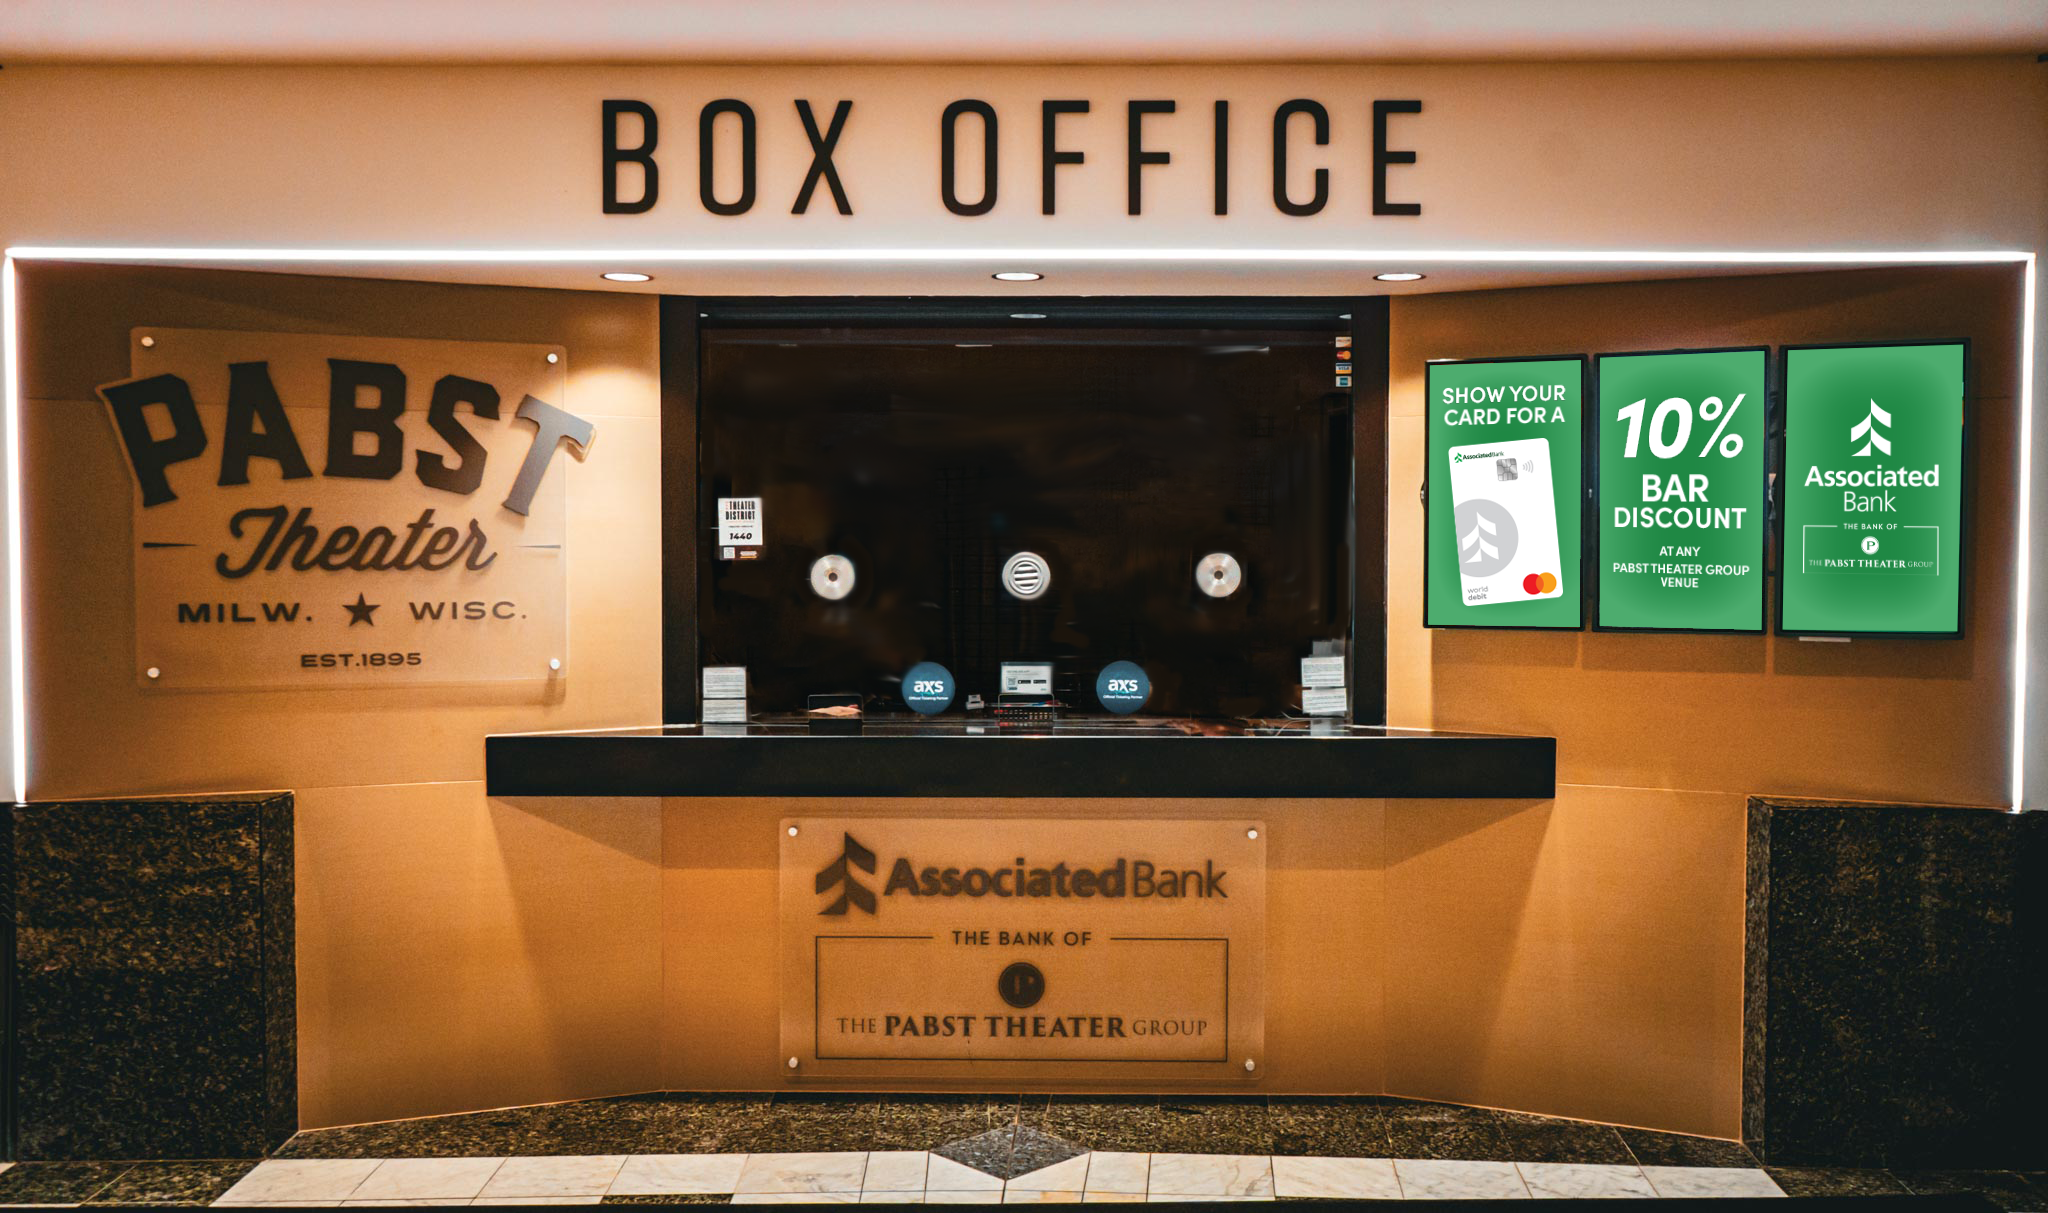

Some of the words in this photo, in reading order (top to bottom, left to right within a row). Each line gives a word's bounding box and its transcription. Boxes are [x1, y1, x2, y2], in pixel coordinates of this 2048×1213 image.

[601, 99, 854, 216] BOX
[941, 98, 1425, 217] OFFICE
[1442, 386, 1506, 405] SHOW
[1508, 384, 1566, 402] YOUR
[1443, 408, 1501, 426] CARD
[1506, 406, 1547, 425] FOR
[1550, 406, 1566, 423] A
[1616, 393, 1747, 459] 10%
[100, 358, 595, 517] PABST
[1804, 464, 1940, 487] Associated
[1642, 473, 1709, 503] BAR
[729, 501, 755, 509] THEATER
[1843, 489, 1897, 513] Bank
[725, 511, 755, 520] DISTRICT
[1613, 507, 1747, 529] DISCOUNT
[216, 504, 497, 580] Theater
[1659, 545, 1674, 557] AT
[1676, 546, 1701, 557] ANY
[1612, 562, 1649, 574] PABST
[1650, 563, 1703, 575] THEATER
[1705, 565, 1750, 576] GROUP
[1824, 559, 1856, 568] PABST
[1857, 559, 1906, 569] THEATER
[1467, 585, 1489, 594] world
[1660, 576, 1699, 588] VENUE
[1467, 593, 1488, 601] debit
[178, 602, 313, 624] MILW.
[408, 601, 527, 621] WISC.
[301, 652, 422, 668] EST.1895
[913, 680, 944, 694] axs
[1108, 680, 1138, 693] axs
[883, 857, 1127, 898] Associated
[1132, 860, 1229, 898] Bank
[951, 930, 991, 946] THE
[998, 930, 1055, 947] BANK
[1063, 931, 1092, 947] OF
[836, 1017, 877, 1034] THE
[884, 1015, 976, 1037] PABST
[984, 1015, 1127, 1038] THEATER
[1132, 1019, 1208, 1036] GROUP
